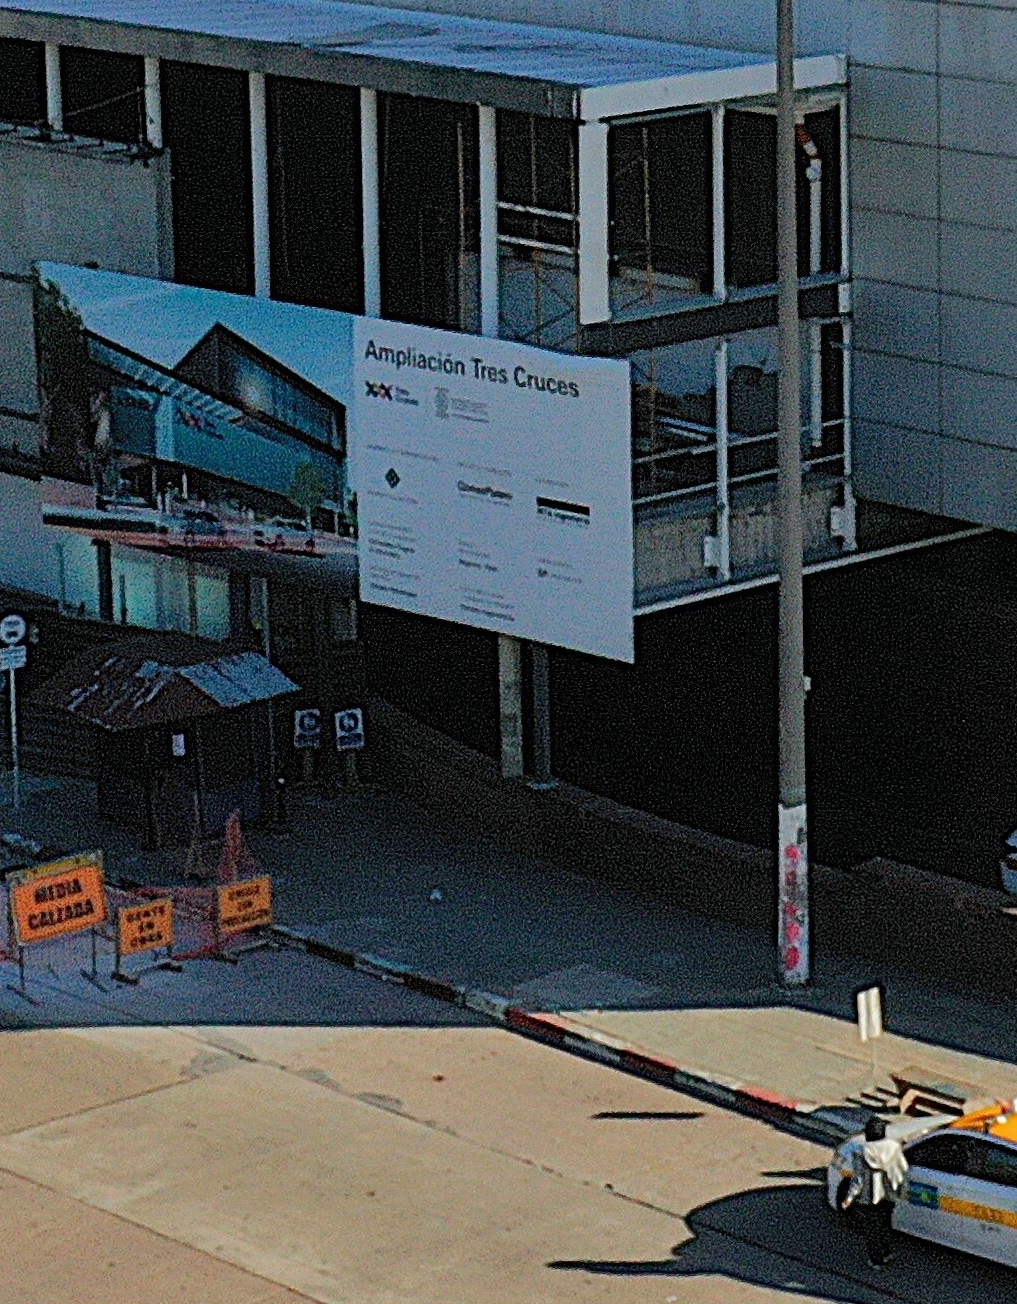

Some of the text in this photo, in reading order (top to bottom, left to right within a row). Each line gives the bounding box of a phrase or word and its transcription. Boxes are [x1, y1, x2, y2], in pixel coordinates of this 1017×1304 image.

[364, 339, 580, 398] Ampliación Tres Cruces
[34, 878, 83, 904] MEDIA
[28, 898, 95, 930] CALZADA
